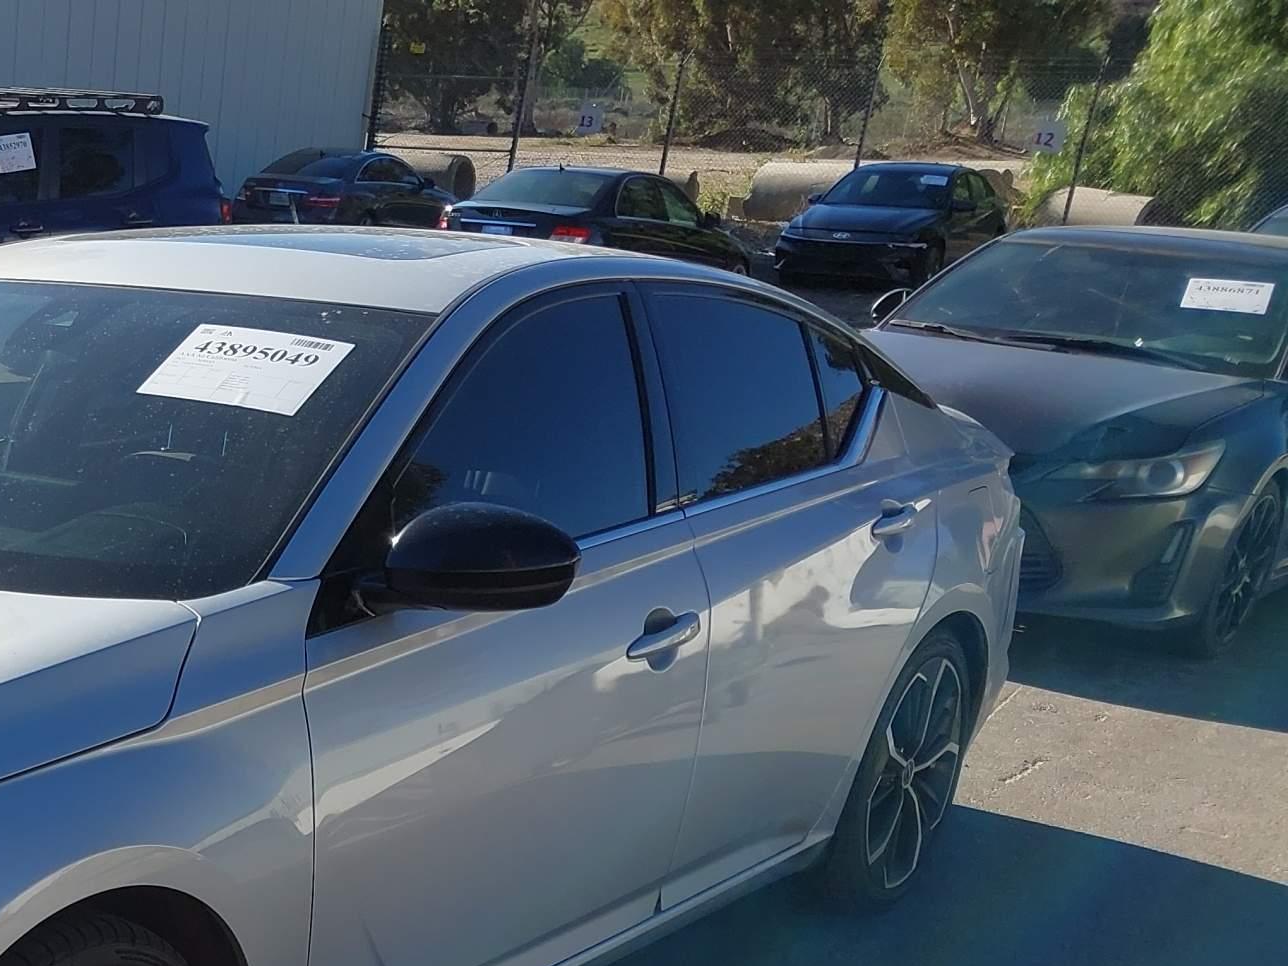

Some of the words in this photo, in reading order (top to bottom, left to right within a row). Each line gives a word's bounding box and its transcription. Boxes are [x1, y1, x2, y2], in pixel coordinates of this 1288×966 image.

[579, 115, 594, 128] 13
[1035, 132, 1054, 147] 12
[194, 339, 320, 367] 43895049
